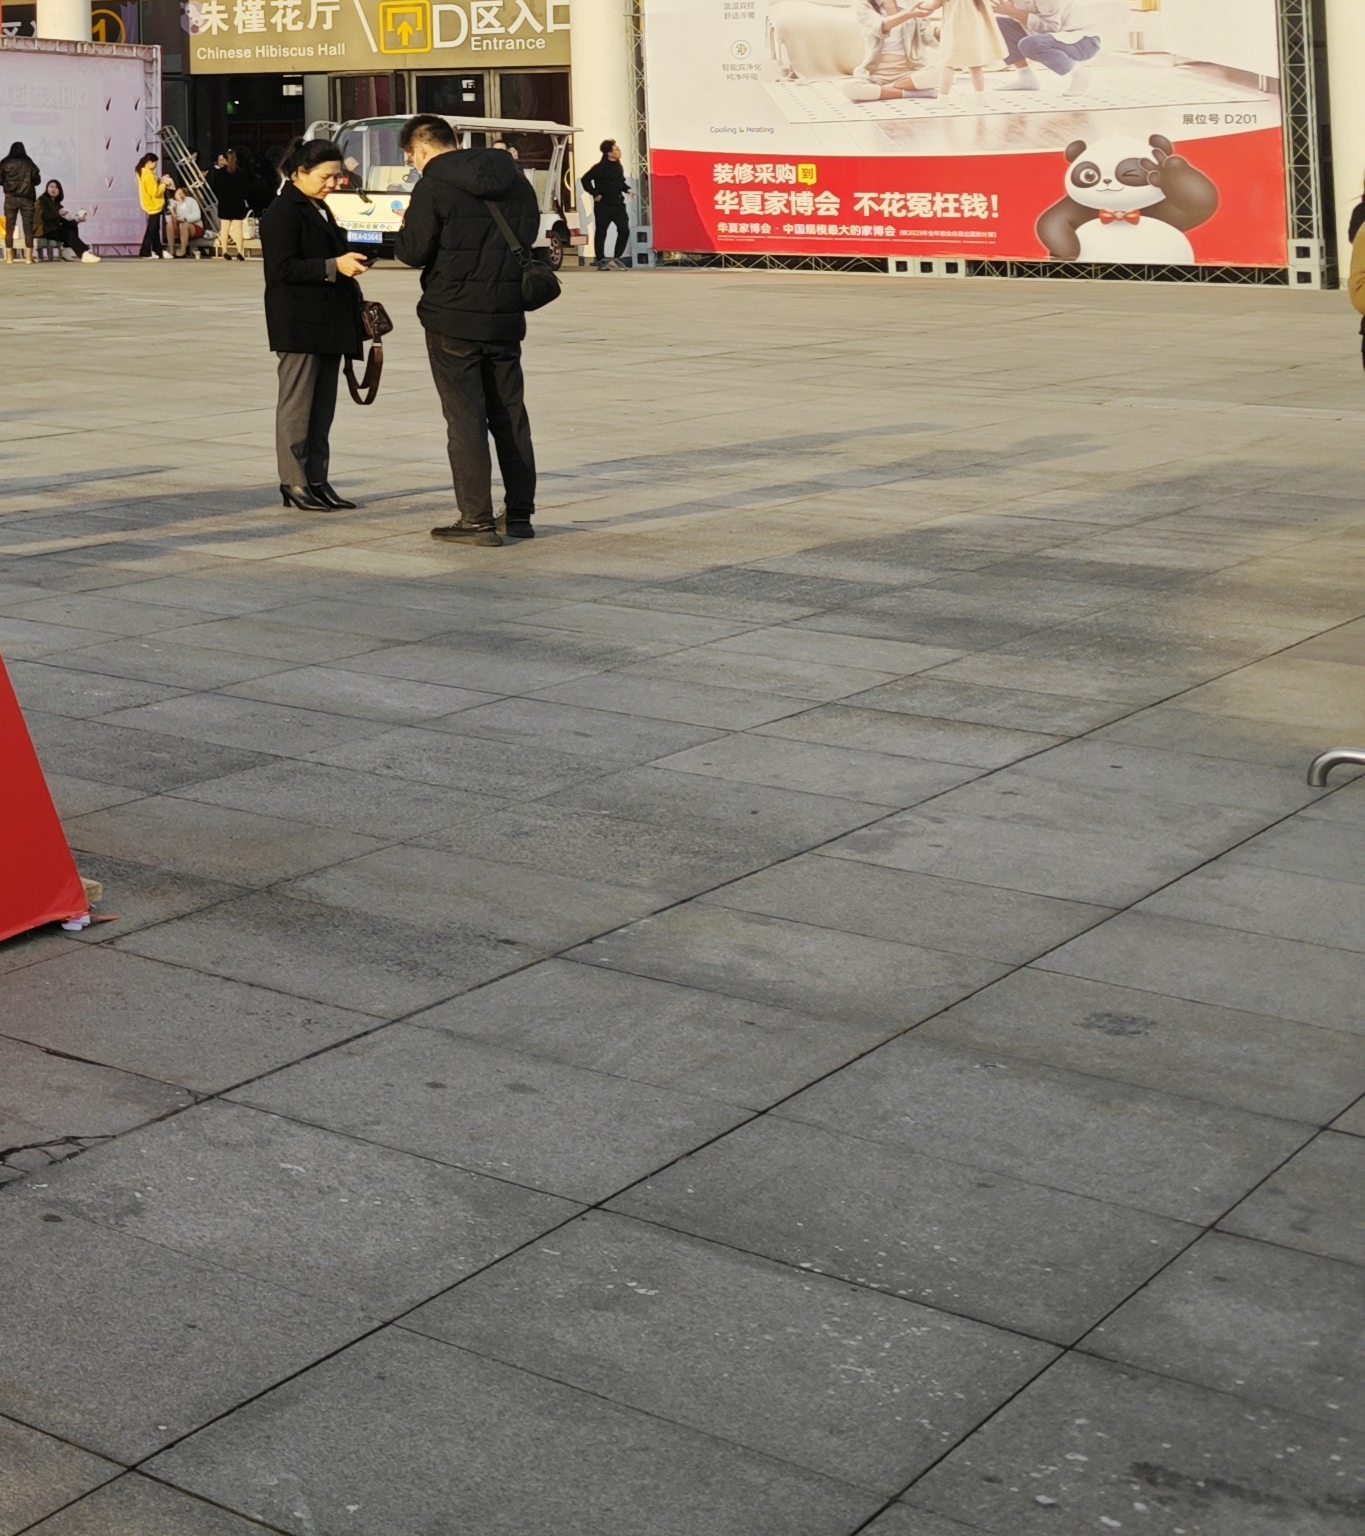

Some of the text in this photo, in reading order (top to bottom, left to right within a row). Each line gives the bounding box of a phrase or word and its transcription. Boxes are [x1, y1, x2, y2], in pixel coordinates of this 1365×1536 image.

[196, 42, 347, 61] Chinese Hibiscus Hall
[470, 35, 546, 52] Entrance
[1181, 112, 1258, 127] 展位号 D201
[713, 189, 841, 217] 华夏家博会
